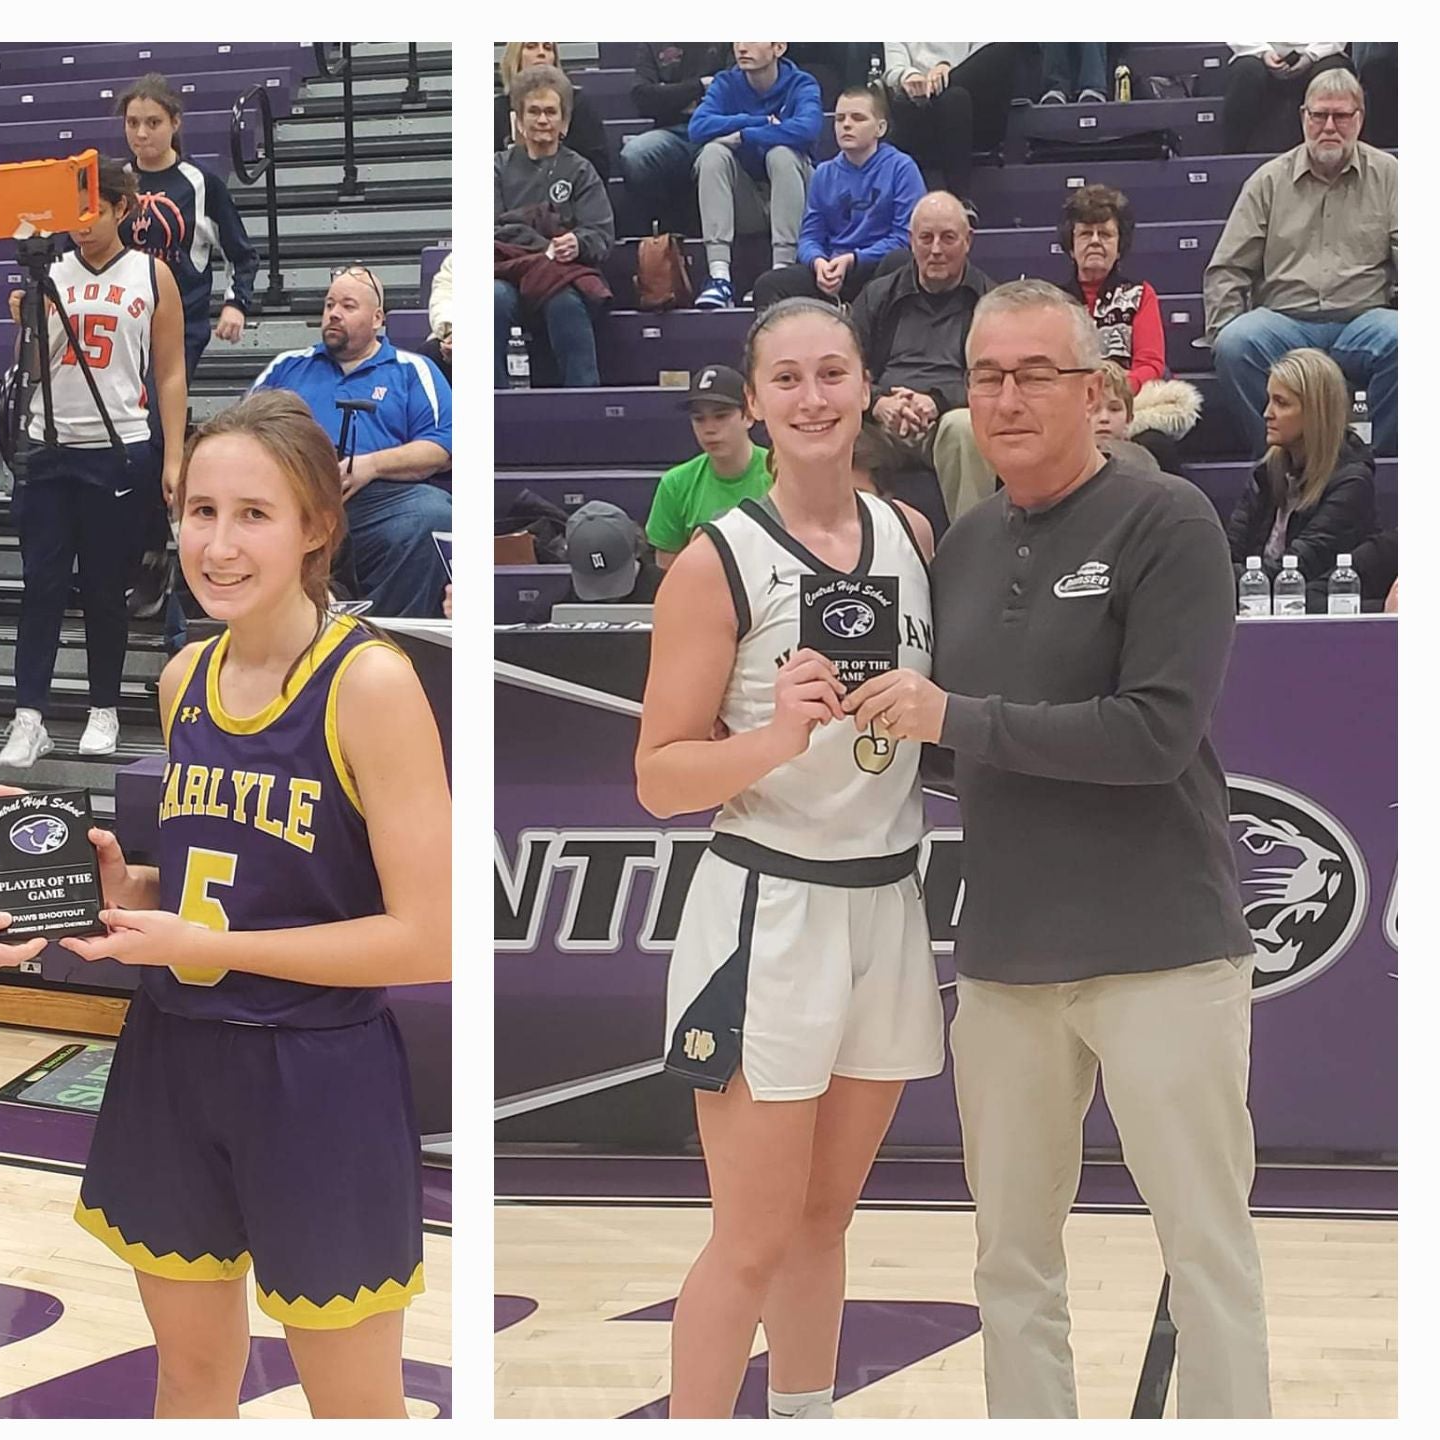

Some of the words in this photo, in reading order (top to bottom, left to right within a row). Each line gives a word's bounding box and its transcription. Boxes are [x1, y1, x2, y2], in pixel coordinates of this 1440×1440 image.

[48, 283, 146, 319] IONS
[60, 313, 118, 369] 15
[699, 370, 717, 389] C
[805, 582, 835, 607] Central
[836, 580, 860, 595] High
[861, 584, 893, 607] School
[851, 660, 867, 670] OF
[868, 660, 890, 670] THE
[836, 671, 865, 682] AME
[21, 795, 48, 811] High
[49, 797, 86, 818] School
[159, 762, 322, 853] ARLYLE
[47, 876, 65, 888] OF
[66, 873, 93, 885] THE
[28, 888, 66, 901] GAME
[12, 912, 38, 923] PAWS
[38, 908, 86, 920] SHOOTOUT
[168, 845, 239, 988] 5
